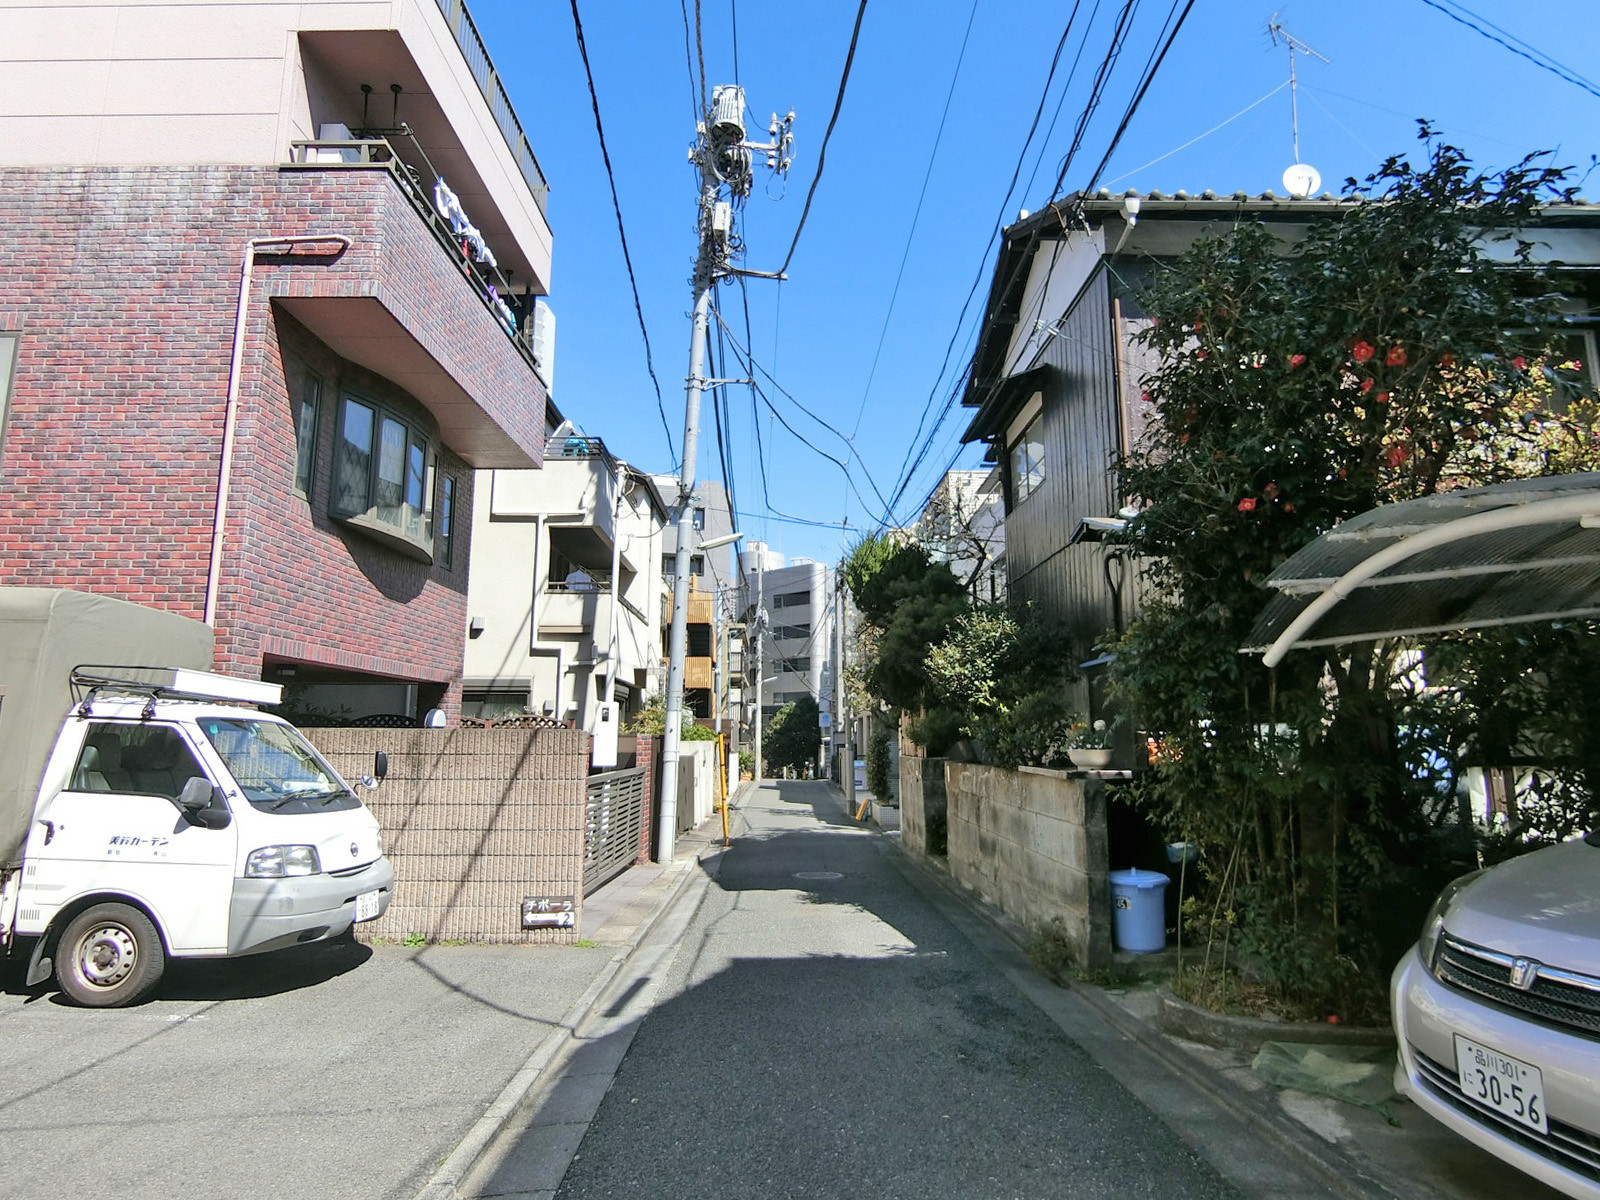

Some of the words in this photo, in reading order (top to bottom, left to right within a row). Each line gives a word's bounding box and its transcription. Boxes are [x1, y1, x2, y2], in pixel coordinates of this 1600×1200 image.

[563, 912, 571, 926] 2
[1463, 1069, 1474, 1085] に
[1475, 1068, 1540, 1124] 30-56
